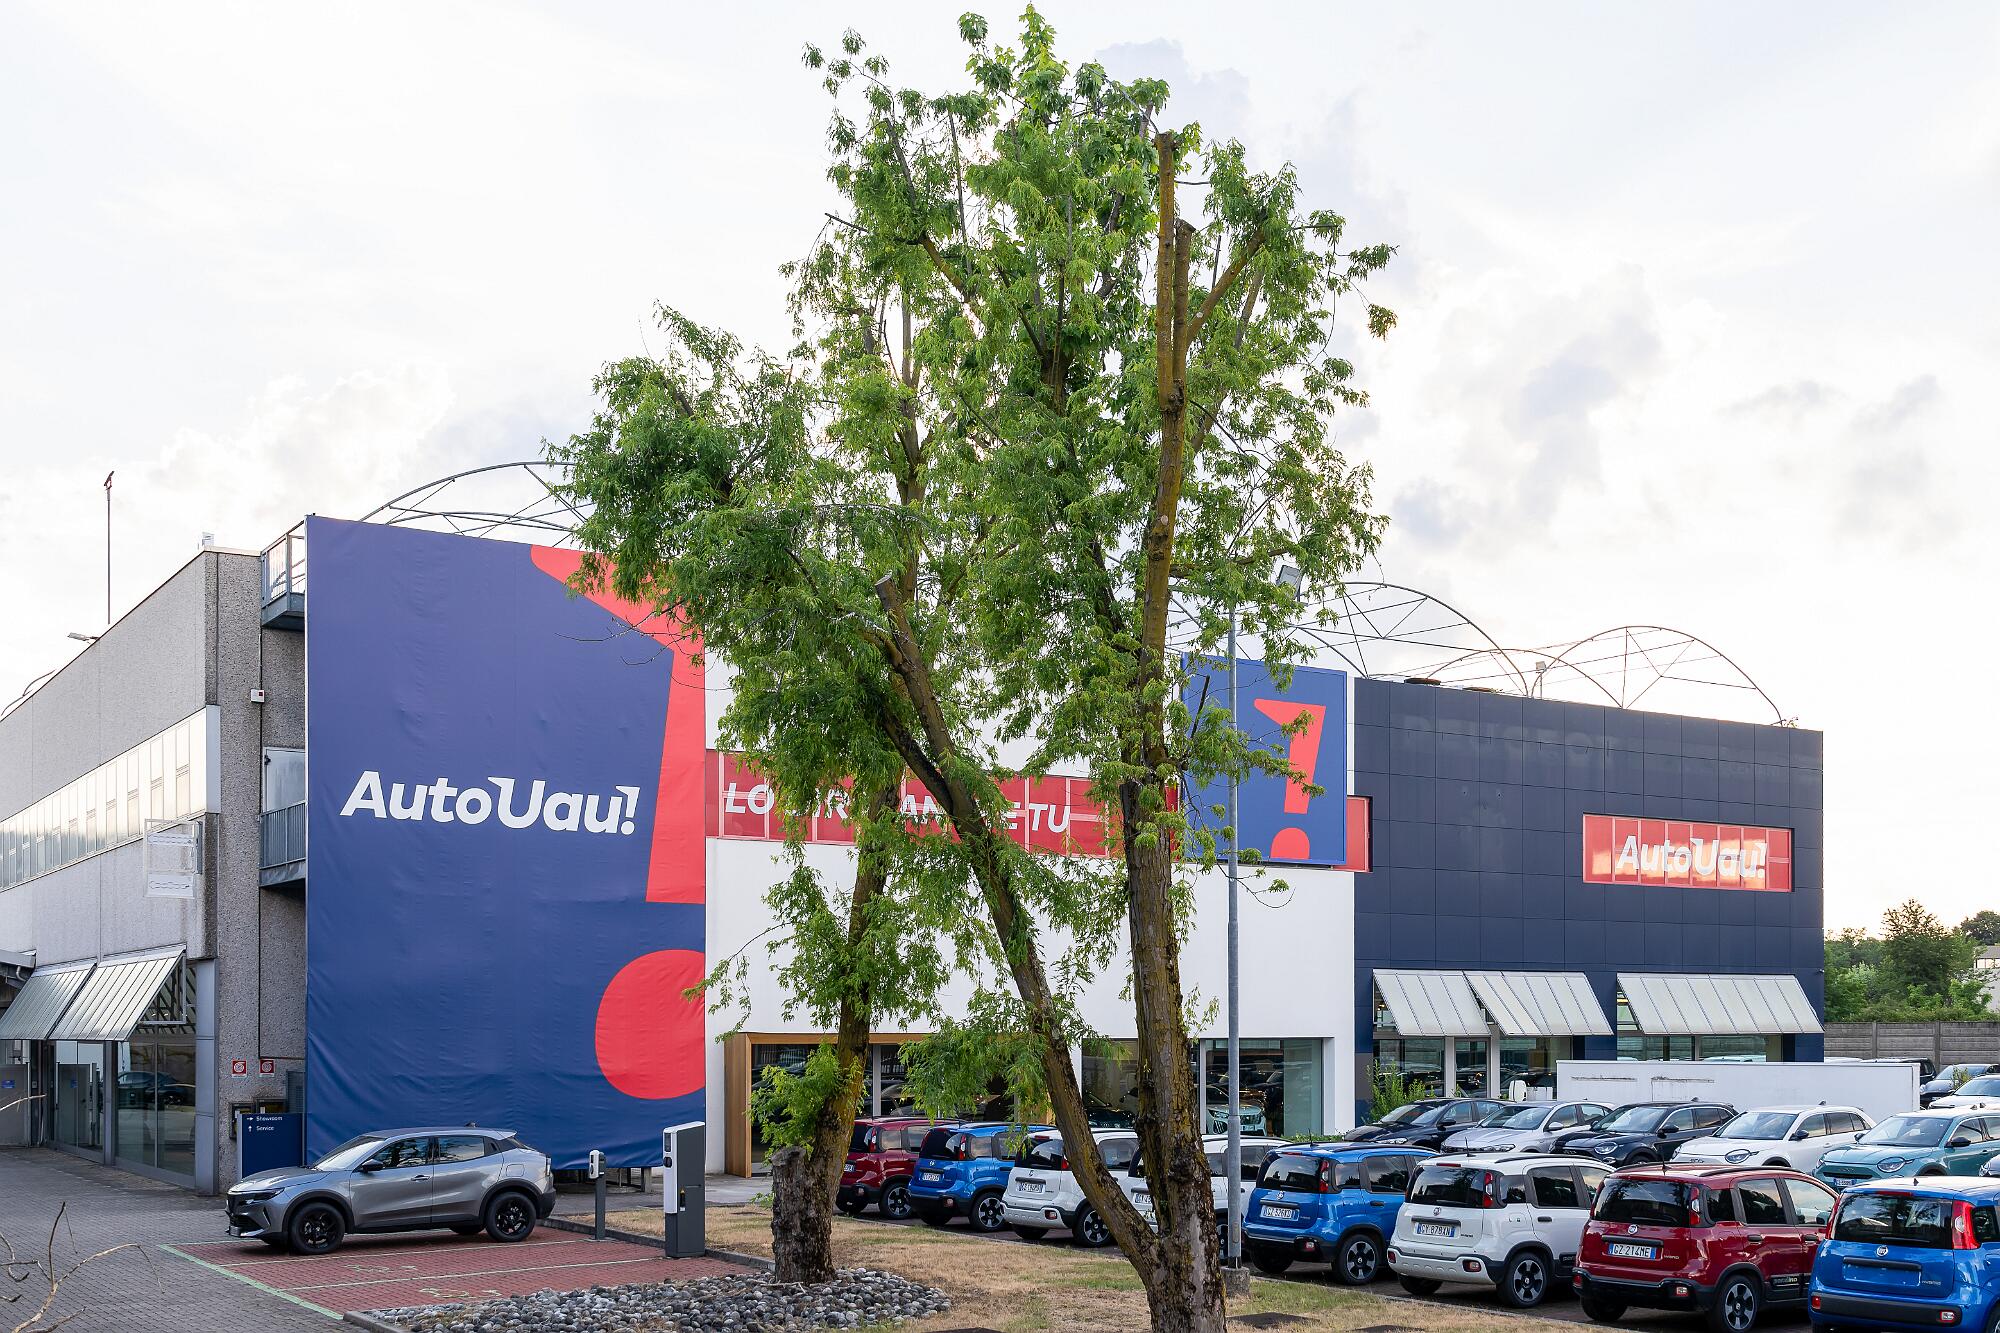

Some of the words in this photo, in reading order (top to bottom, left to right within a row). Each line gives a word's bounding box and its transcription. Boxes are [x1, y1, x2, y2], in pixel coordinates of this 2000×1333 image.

[340, 770, 640, 835] AutoUau!
[725, 782, 775, 814] LO
[1029, 803, 1070, 833] TU
[1614, 835, 1768, 878] AutoUau!
[1614, 1244, 1624, 1254] GZ
[1625, 1245, 1650, 1257] 214ME
